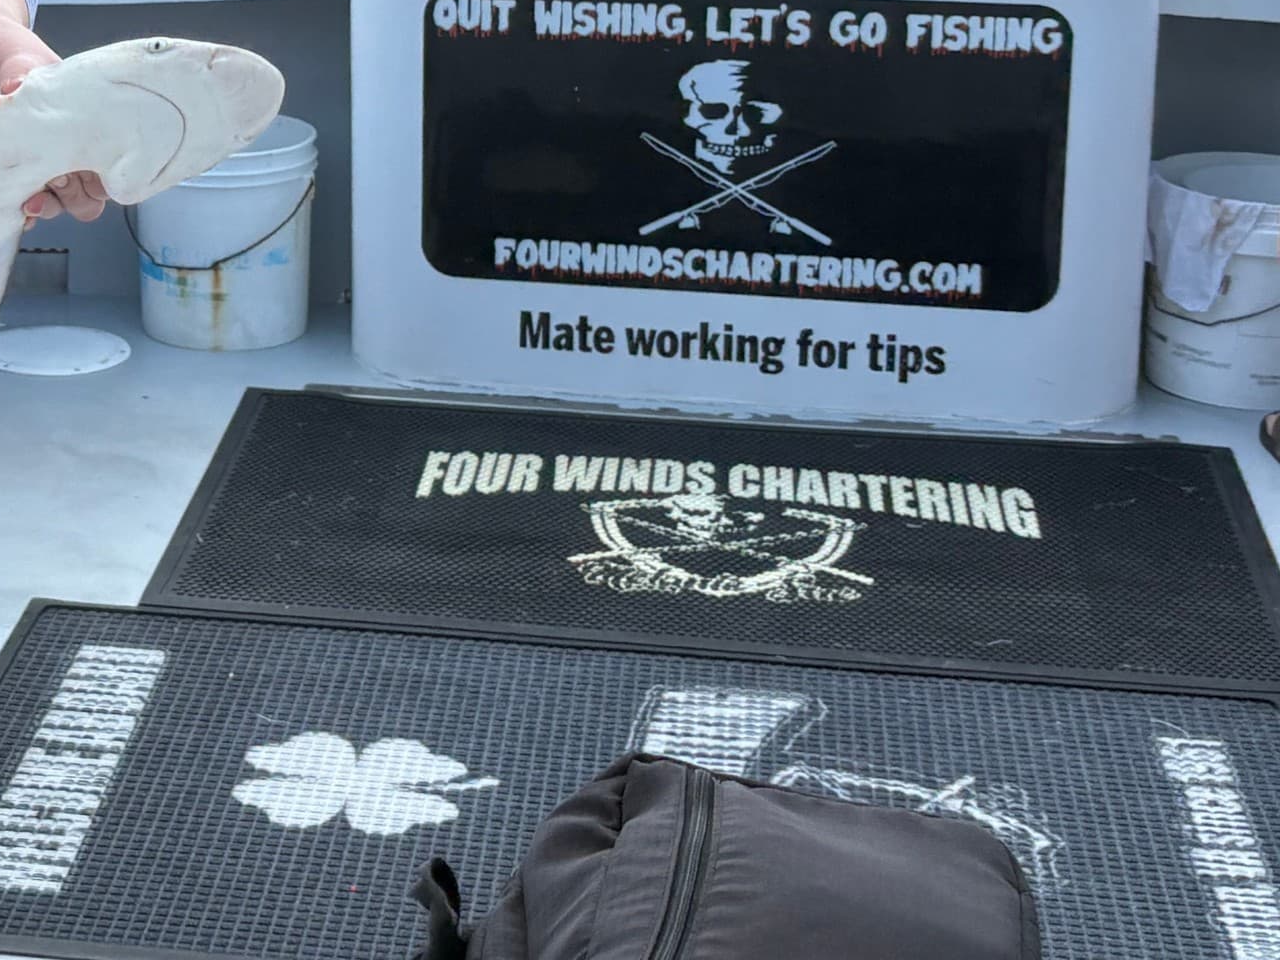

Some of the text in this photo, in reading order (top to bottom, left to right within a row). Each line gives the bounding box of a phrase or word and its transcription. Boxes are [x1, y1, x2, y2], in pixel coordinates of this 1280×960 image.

[534, 0, 694, 43] WISHING,
[705, 4, 811, 43] LET'S
[829, 12, 888, 47] GO
[905, 14, 1064, 53] FISHING
[493, 238, 984, 294] FOURWINDSCHARTERING.COM
[519, 311, 948, 383] Mate working for tips
[416, 451, 1042, 539] FOUR WINDS CHARTERING
